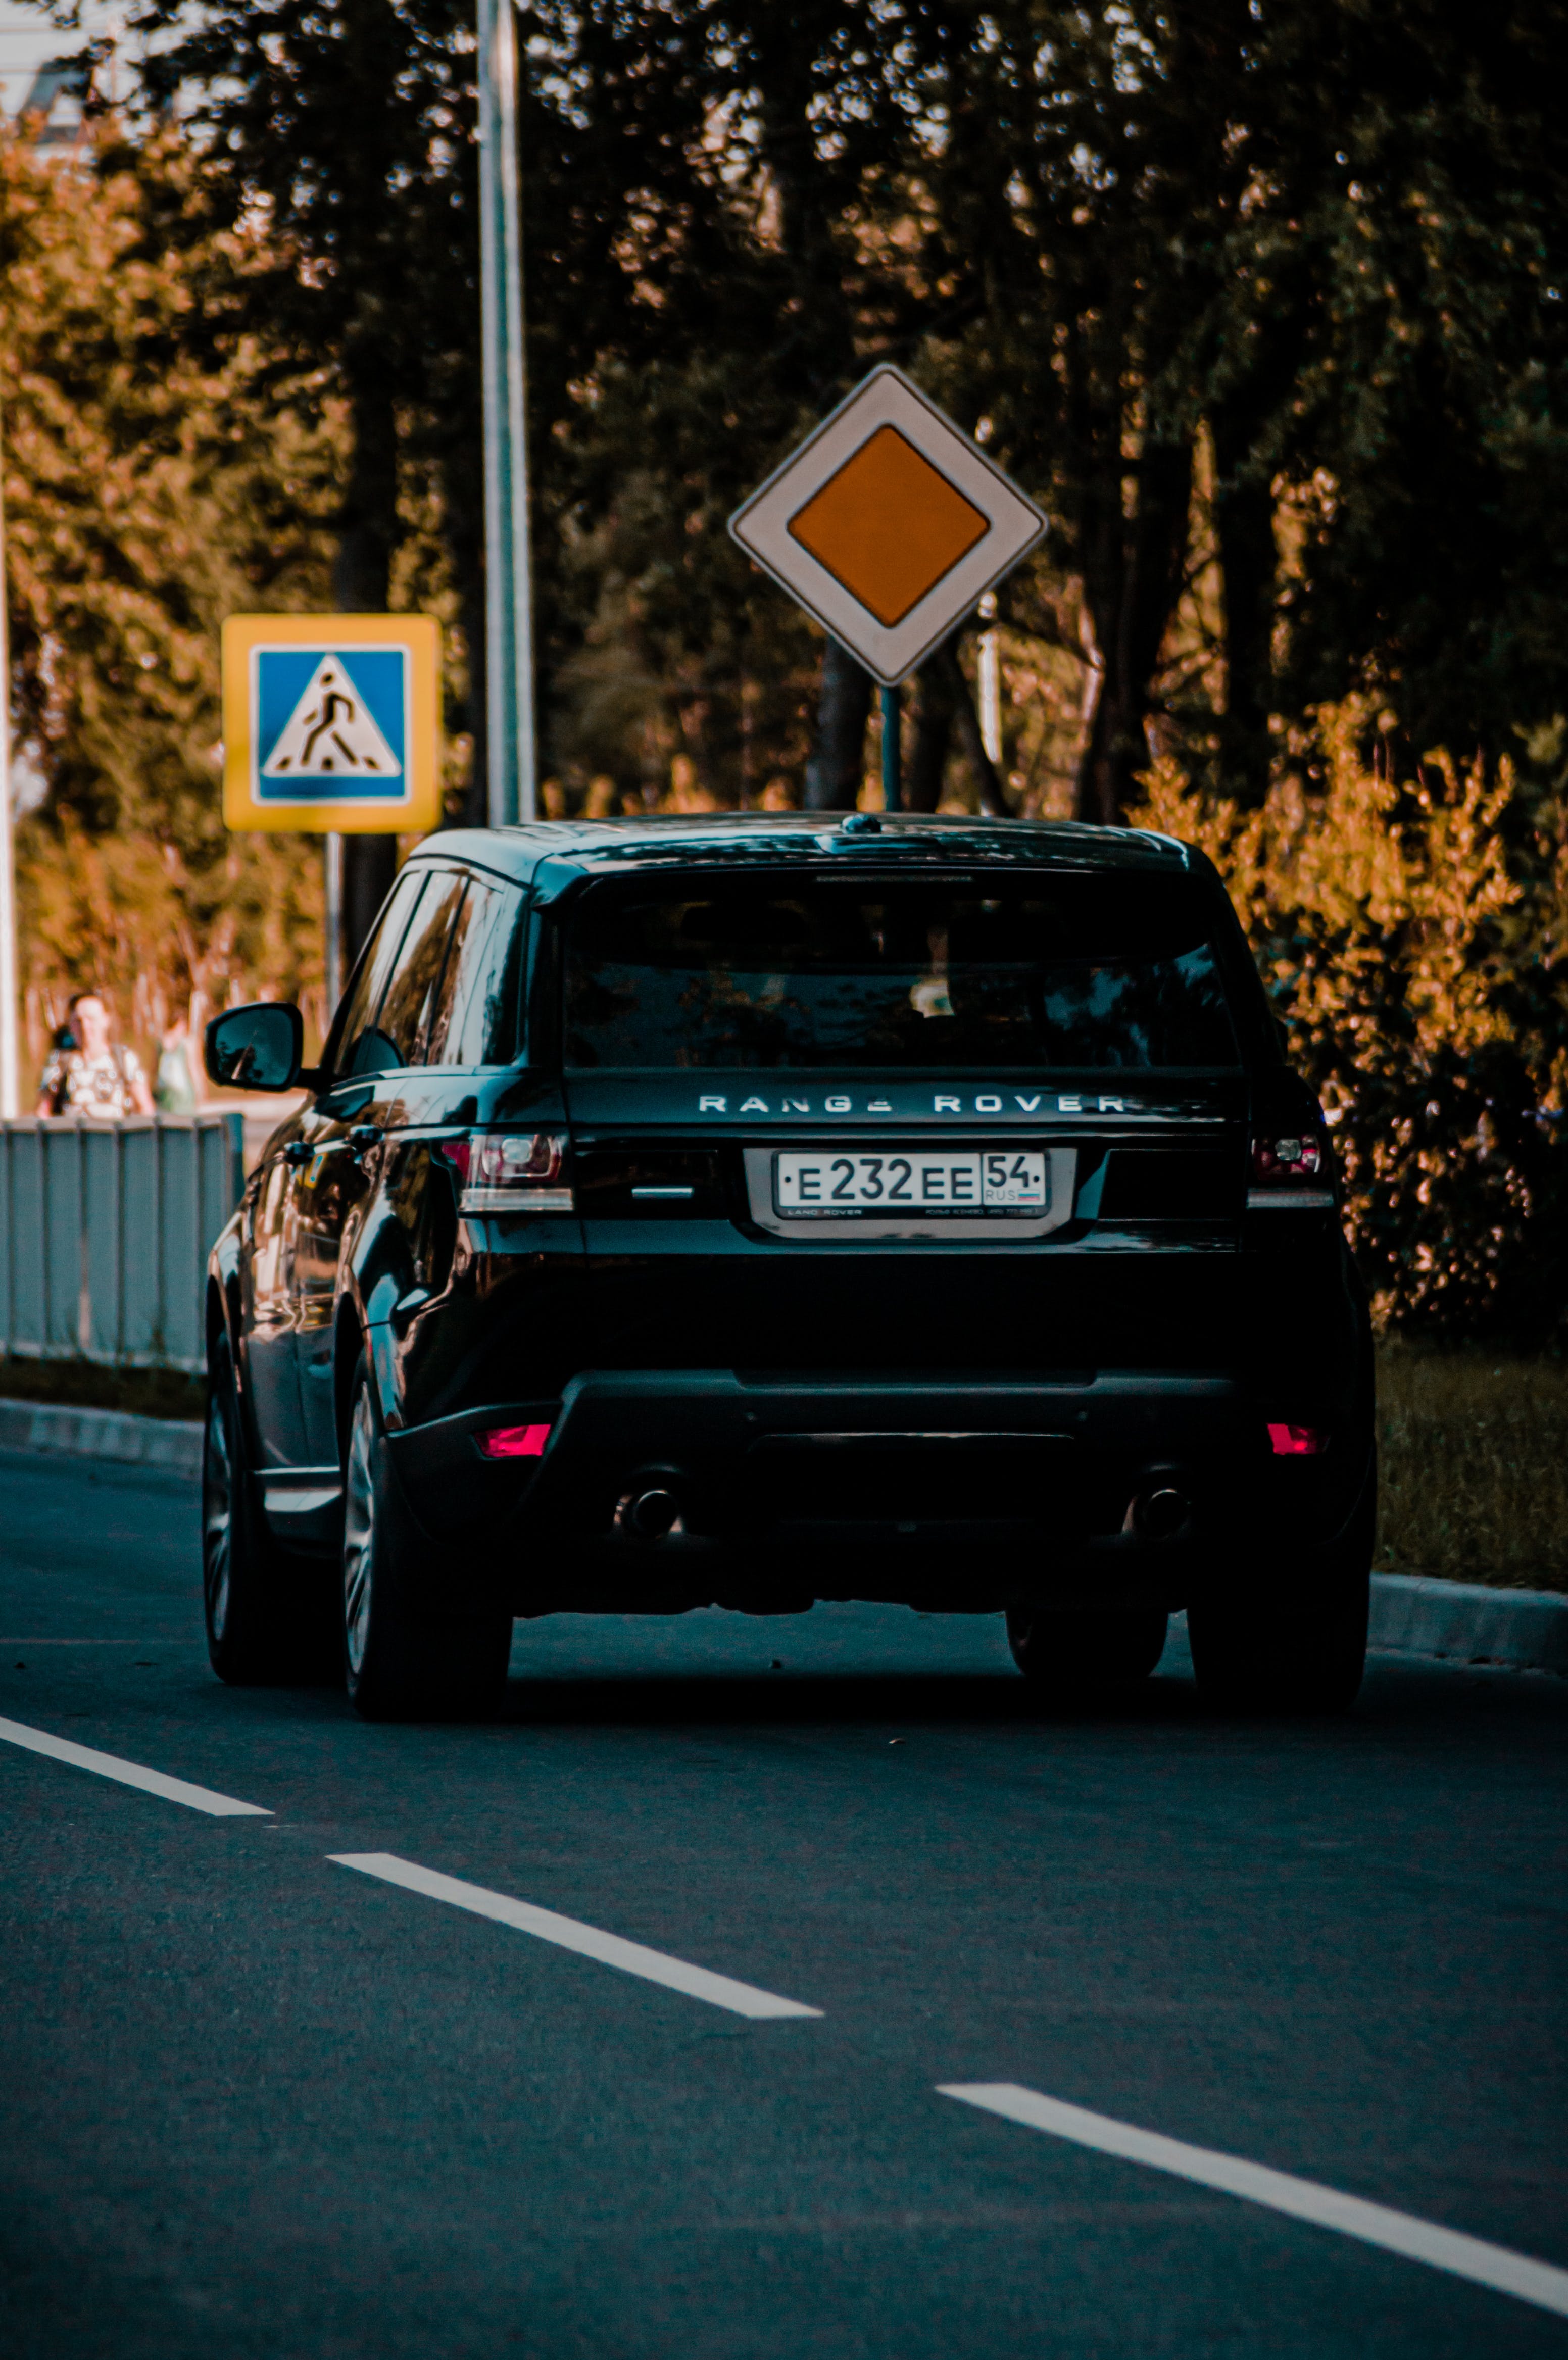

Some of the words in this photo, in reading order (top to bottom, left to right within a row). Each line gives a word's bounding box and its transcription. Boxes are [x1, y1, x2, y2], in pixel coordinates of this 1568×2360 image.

[699, 1096, 892, 1112] RANGE
[934, 1095, 1124, 1112] ROVER
[988, 1156, 1028, 1188] 54
[986, 1190, 1015, 1200] RUS
